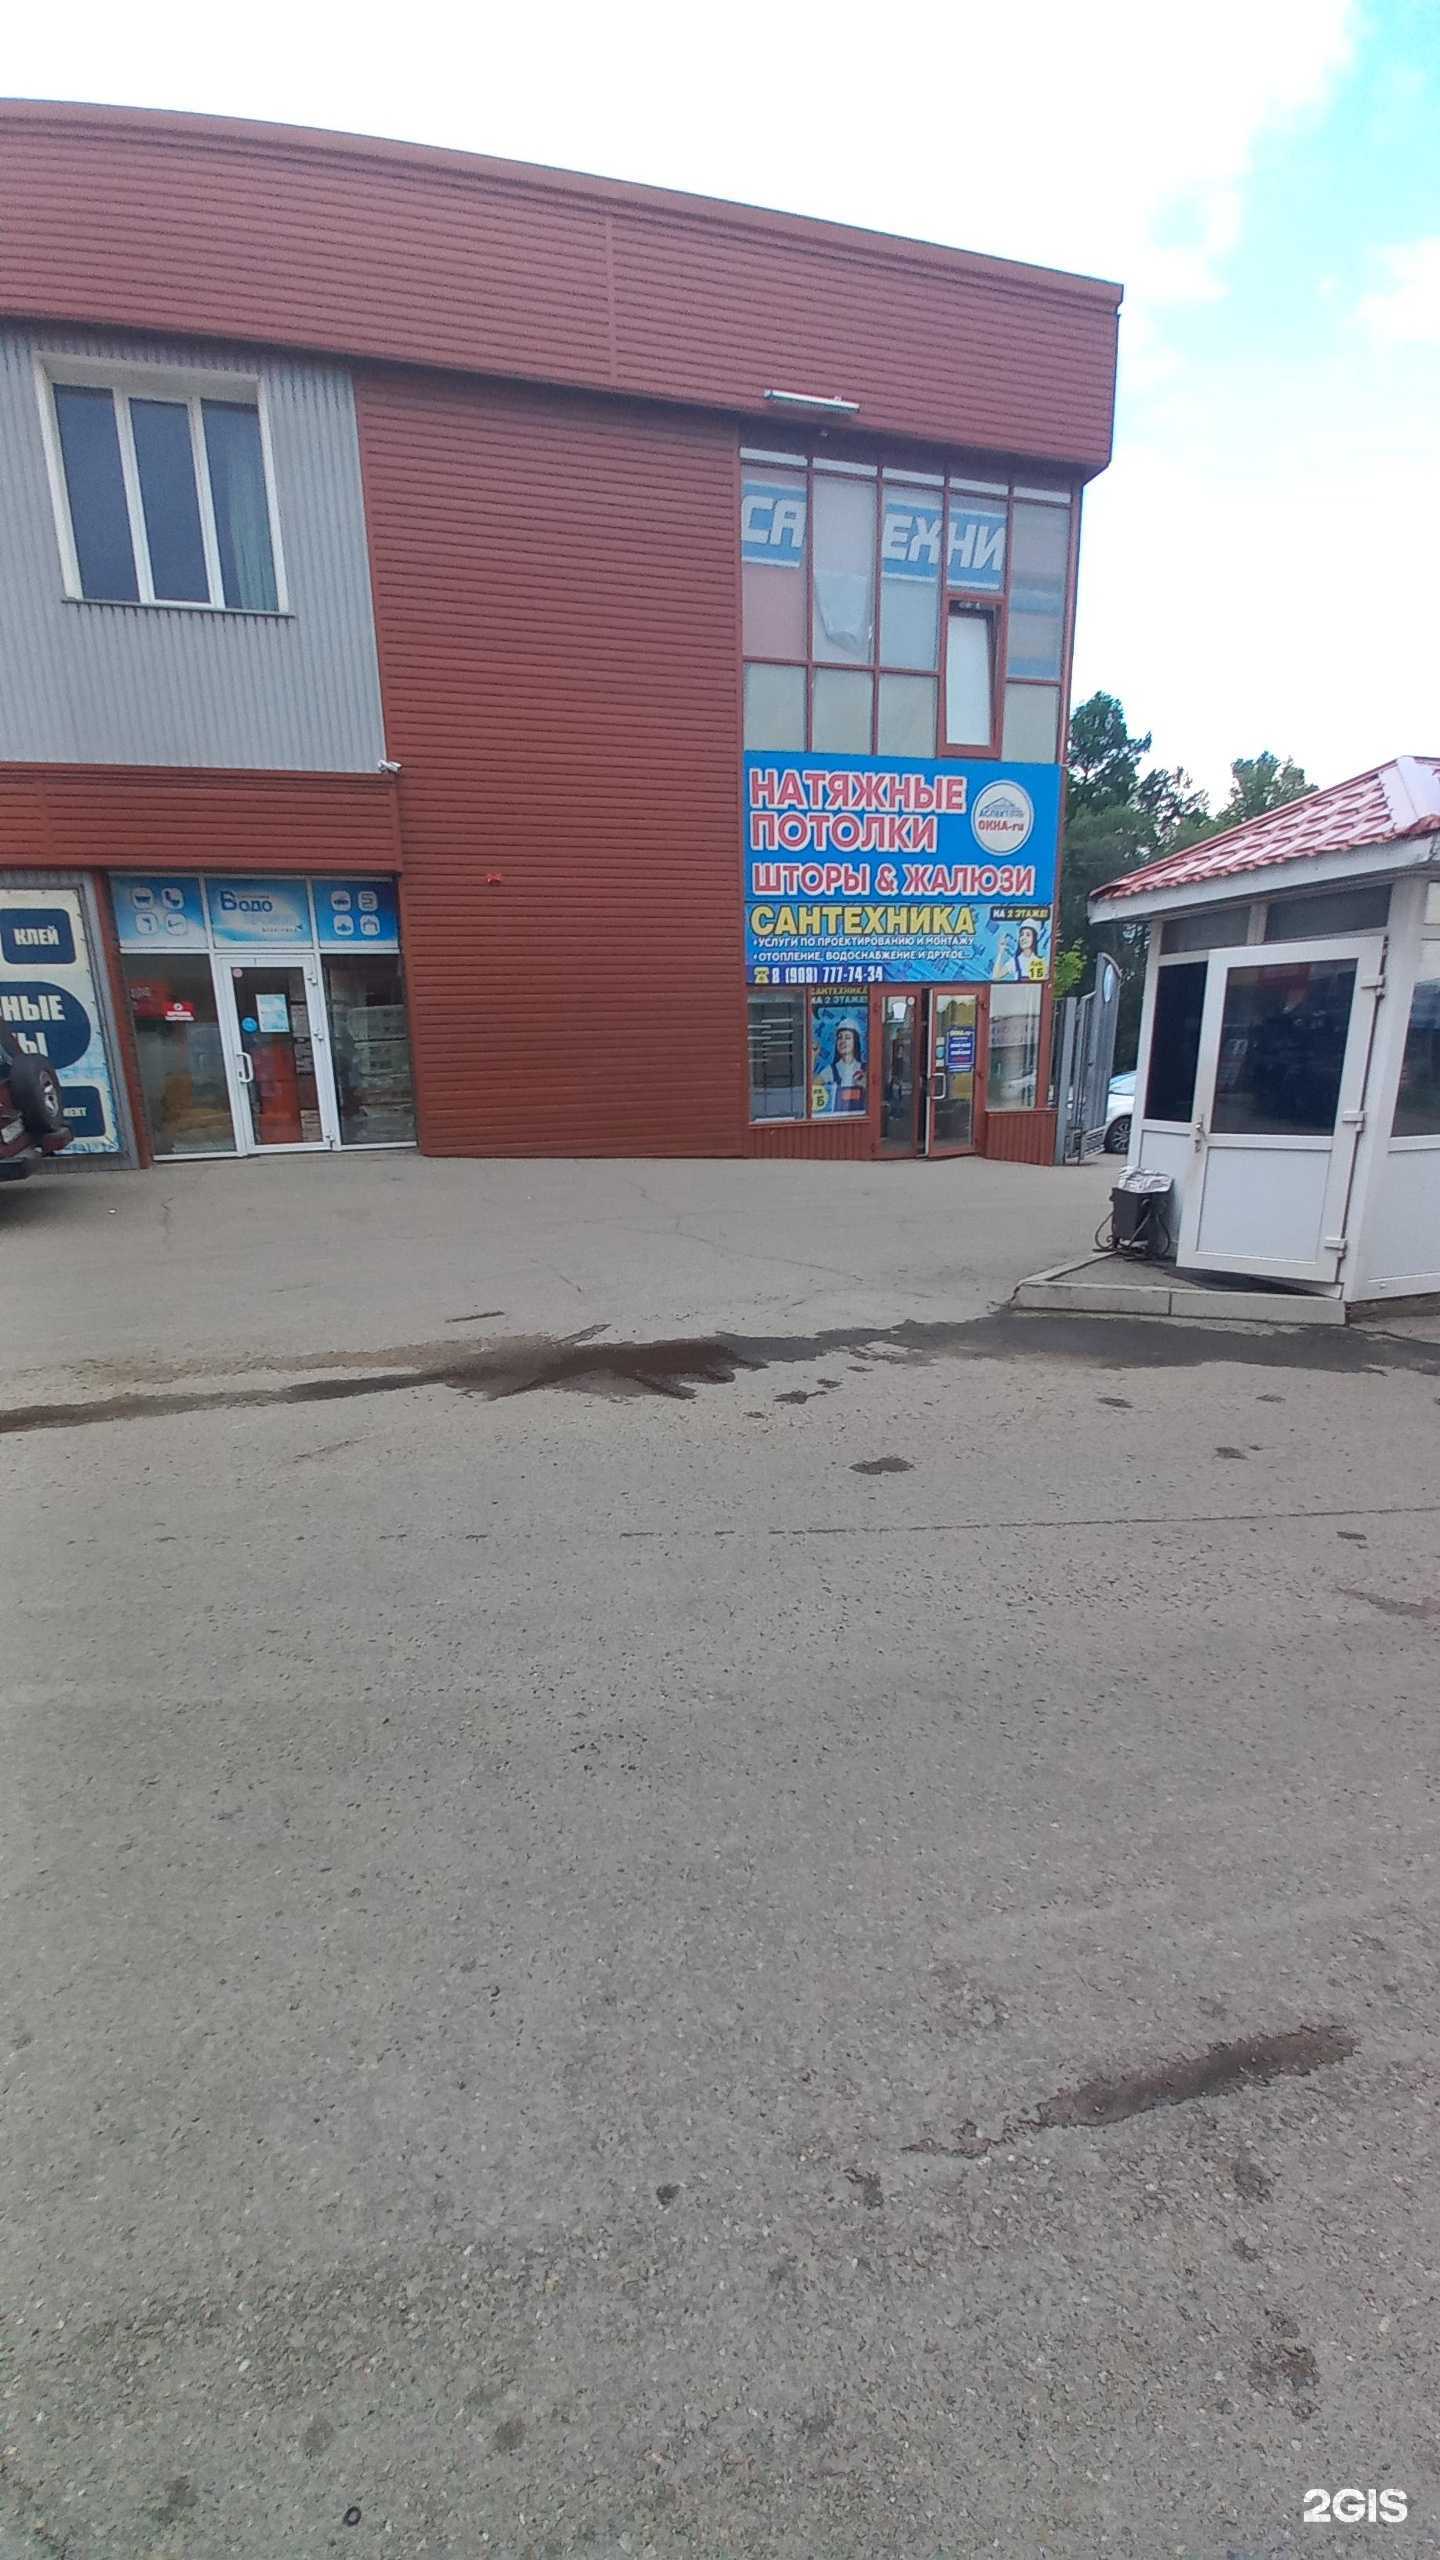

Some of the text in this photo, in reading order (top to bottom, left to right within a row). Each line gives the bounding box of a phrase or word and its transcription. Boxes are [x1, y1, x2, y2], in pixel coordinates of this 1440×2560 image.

[750, 768, 967, 814] НАТЯЖНЫЕ
[750, 811, 937, 853] ПОТОЛКИ
[752, 863, 1035, 897] ШТОРЫ & ЖАЛЮЗИ
[751, 904, 976, 936] САНТЕХНИКА
[992, 909, 1006, 918] НА
[13, 926, 59, 945] КЛЕЙ
[758, 937, 798, 948] УСЛУГИ
[799, 937, 815, 947] ПО
[818, 937, 914, 947] ПРОЕКТИРОВАНИЮ
[926, 936, 974, 946] МОНТАЖУ
[826, 950, 917, 961] ВОДОСНАБЖЕНИЕ
[771, 967, 780, 984] 8
[823, 966, 883, 983] 777-74-34
[0, 995, 65, 1021] НЫЕ
[12, 1031, 49, 1058] Ы
